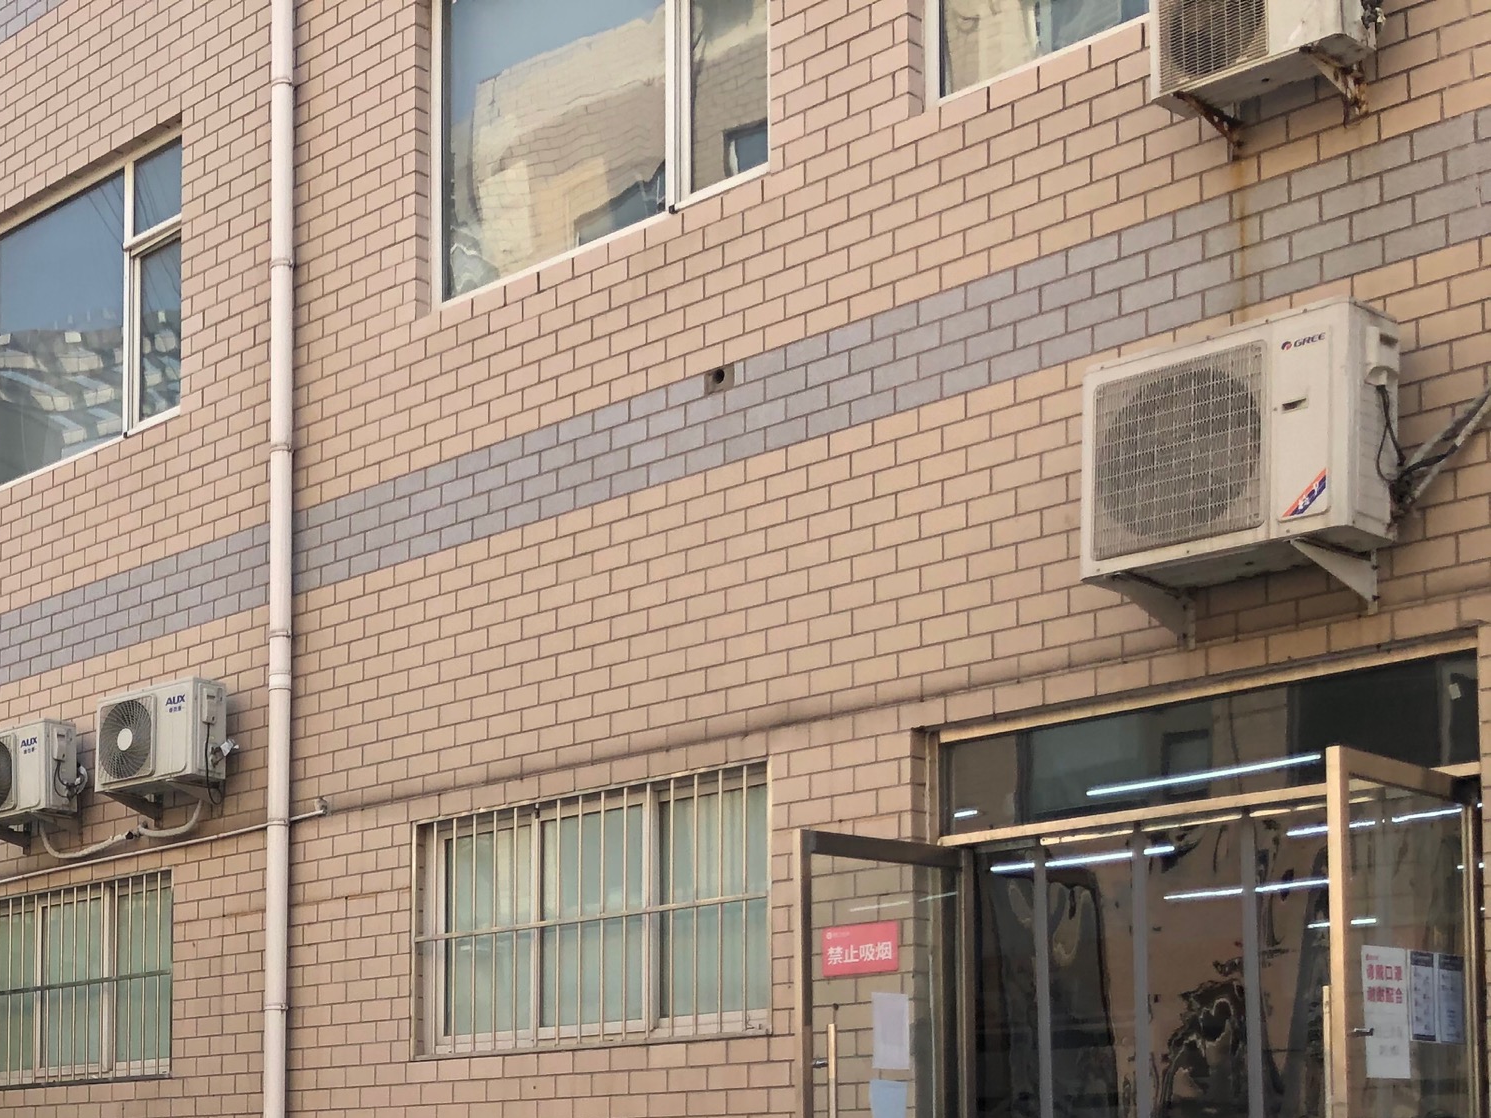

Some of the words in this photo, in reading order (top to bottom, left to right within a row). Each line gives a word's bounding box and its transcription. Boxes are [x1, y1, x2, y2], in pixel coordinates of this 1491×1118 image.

[1294, 332, 1326, 348] GREE
[165, 694, 185, 706] AUX
[20, 736, 37, 748] AUX
[827, 941, 893, 965] 禁止吸烟
